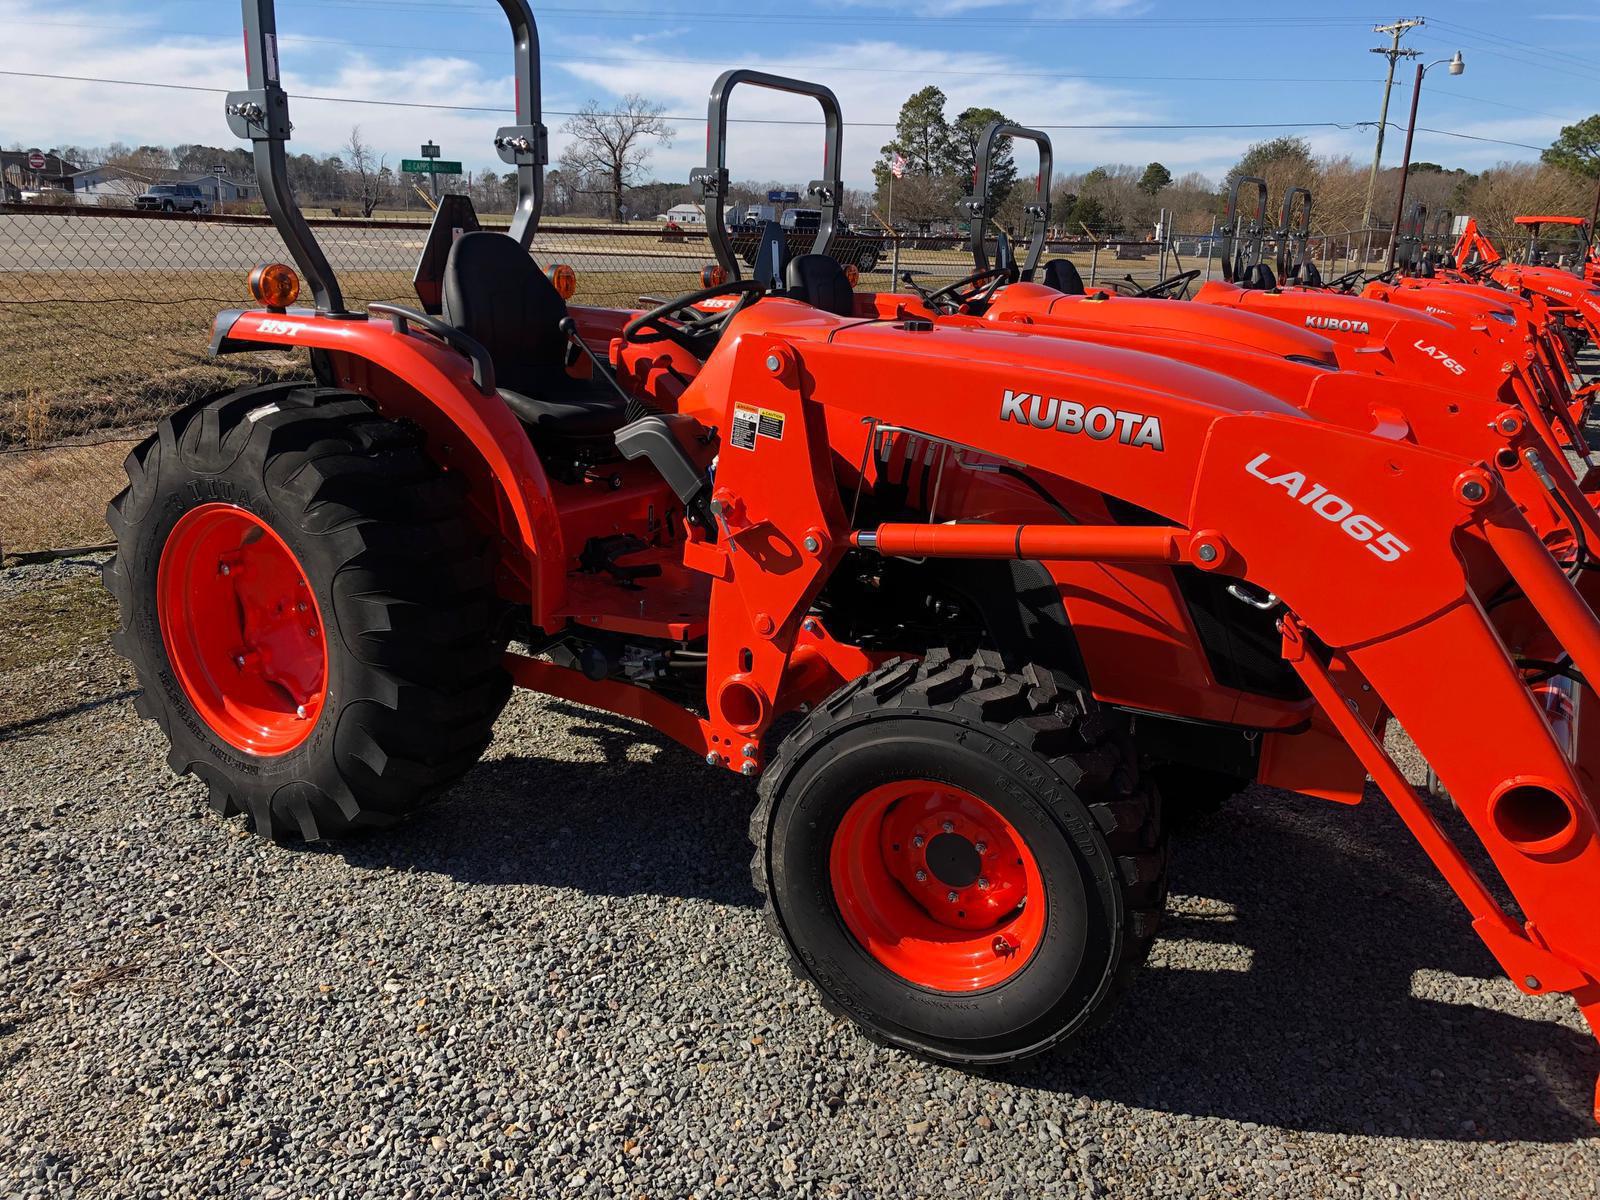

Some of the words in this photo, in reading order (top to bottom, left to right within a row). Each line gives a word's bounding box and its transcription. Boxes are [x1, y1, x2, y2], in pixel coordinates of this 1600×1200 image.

[256, 319, 306, 336] HST
[1305, 315, 1370, 334] KUBOTA
[1413, 339, 1467, 376] LA765
[765, 411, 783, 419] CAUTION
[1000, 389, 1164, 452] KUBOTA
[1245, 452, 1411, 562] LA1065
[983, 737, 1065, 809] TITAN
